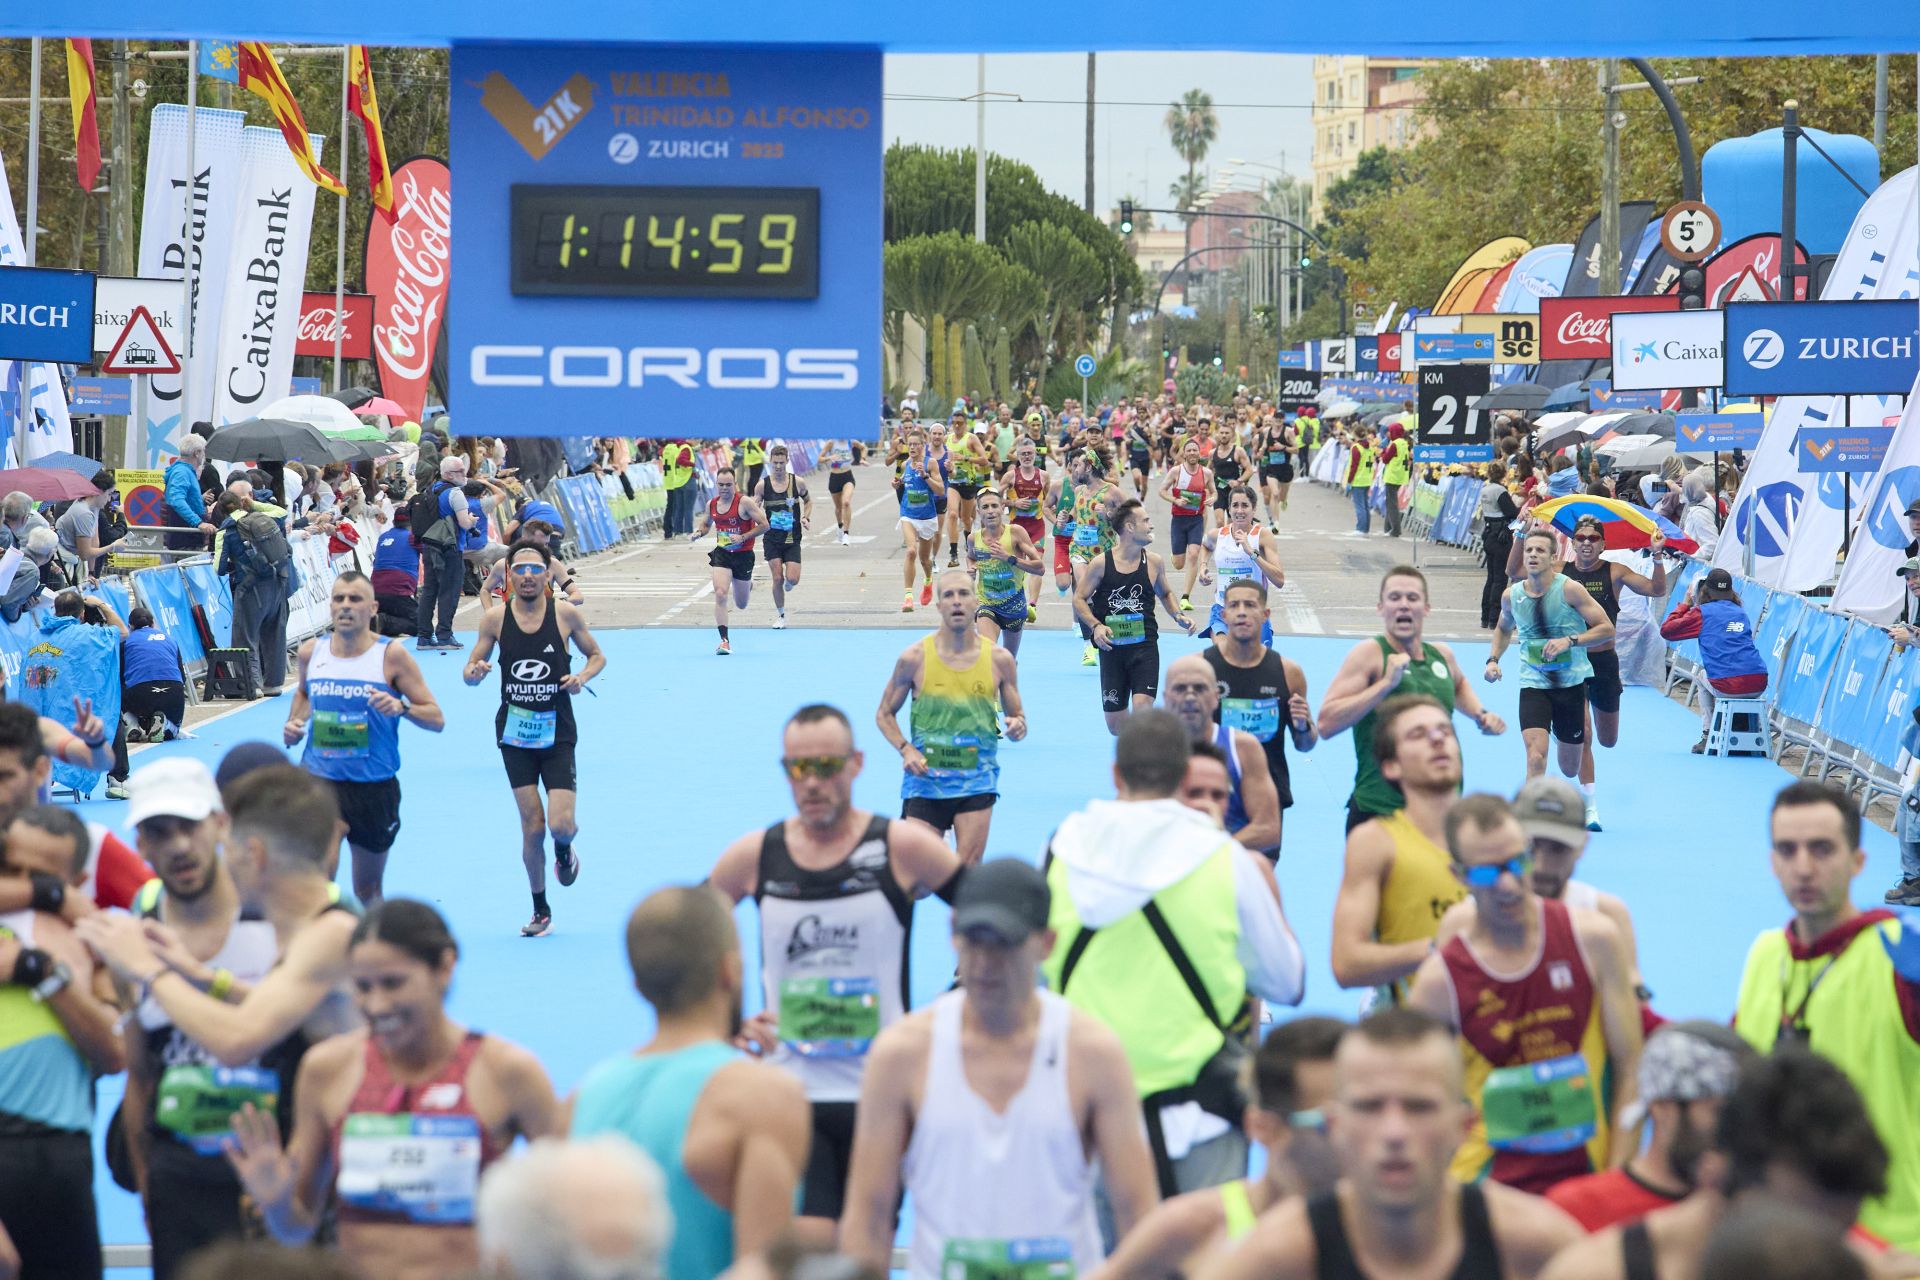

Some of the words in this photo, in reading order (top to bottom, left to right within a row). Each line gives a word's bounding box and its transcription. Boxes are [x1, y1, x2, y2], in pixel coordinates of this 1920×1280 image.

[610, 71, 730, 97] VALENCIA
[532, 88, 583, 145] 21K
[611, 104, 735, 128] TRINIDAD
[741, 106, 870, 129] ALFONSO
[647, 140, 729, 159] ZURICH
[1679, 221, 1695, 241] 5
[228, 186, 292, 405] CaixaBank
[1798, 336, 1911, 360] ZURICH
[470, 345, 859, 390] COROS
[1424, 372, 1443, 384] KM
[1427, 394, 1481, 435] 21
[505, 683, 558, 694] HYUNDAI
[511, 693, 534, 703] Koryo
[535, 693, 551, 702] Car
[518, 720, 543, 730] 24313
